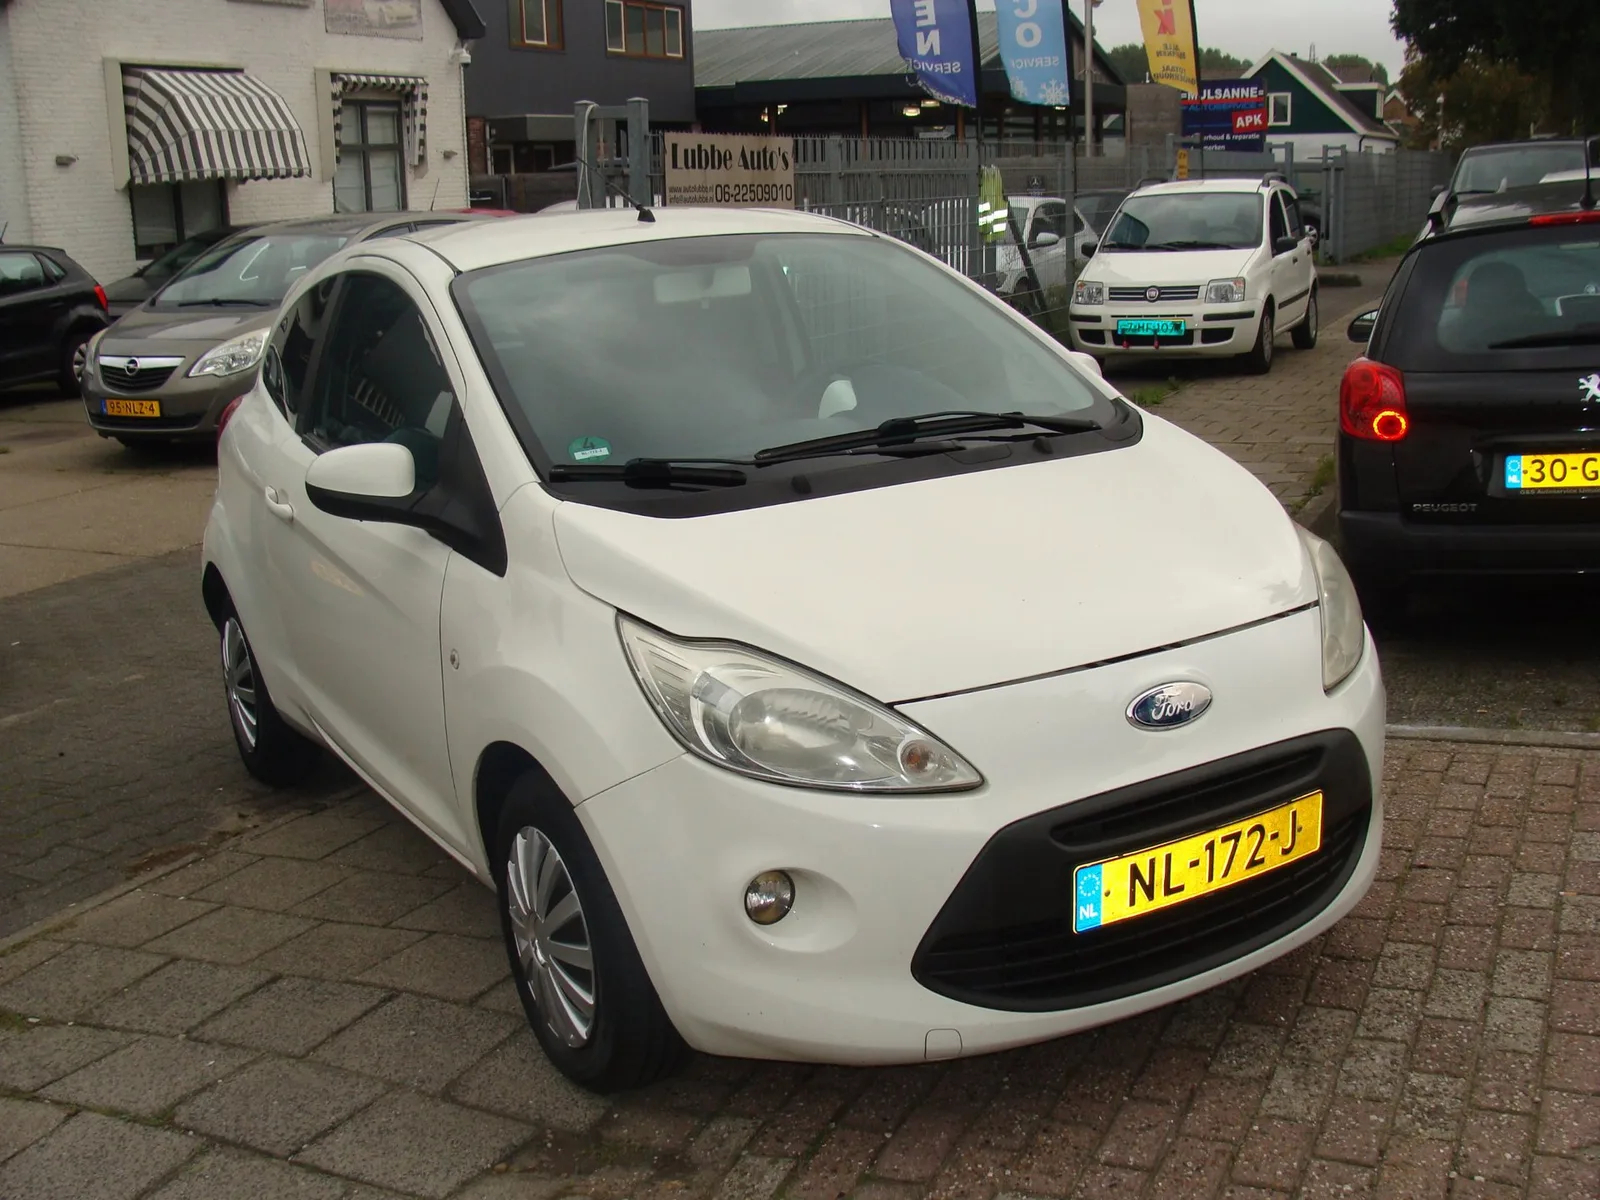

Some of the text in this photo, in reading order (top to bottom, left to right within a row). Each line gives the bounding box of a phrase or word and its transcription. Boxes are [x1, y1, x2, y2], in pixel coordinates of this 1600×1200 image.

[1236, 113, 1263, 128] APK
[671, 142, 789, 171] Lubbe Auto's
[1507, 474, 1521, 483] NL
[1412, 503, 1478, 512] PEUGEOT
[1152, 687, 1196, 721] Ford
[1129, 808, 1298, 907] NL-172-J
[1079, 903, 1099, 920] NL
